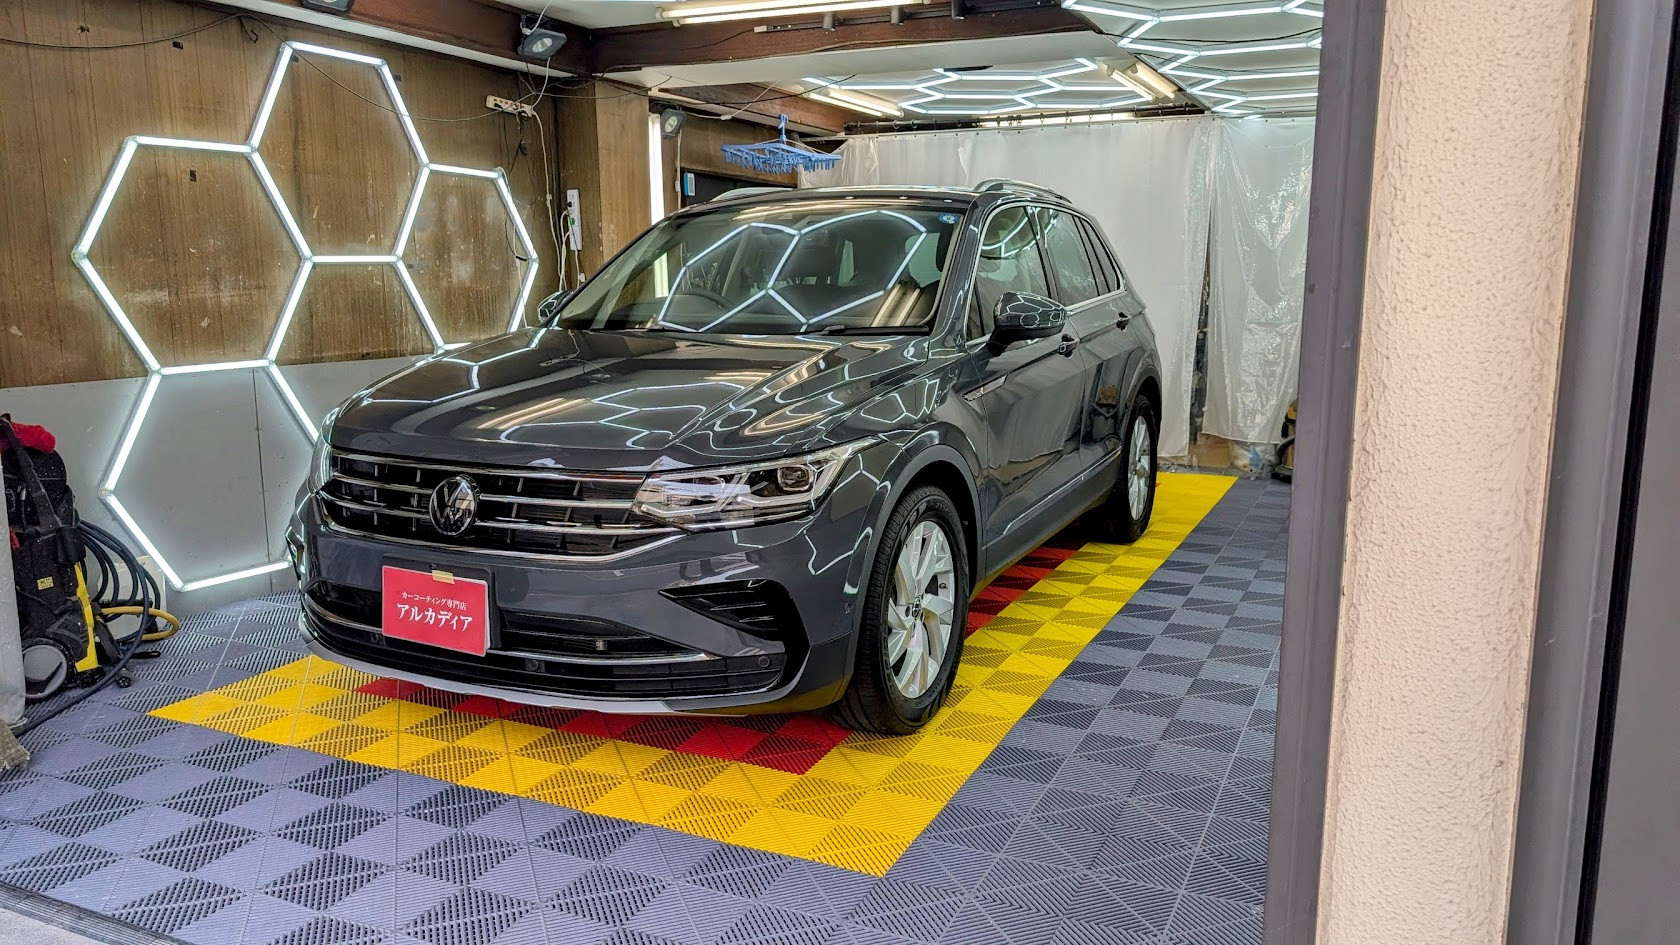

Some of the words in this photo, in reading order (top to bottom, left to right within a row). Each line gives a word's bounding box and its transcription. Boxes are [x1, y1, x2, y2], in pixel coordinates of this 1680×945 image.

[401, 591, 467, 611] カーコーティング専門店
[396, 602, 473, 632] アルカディア
